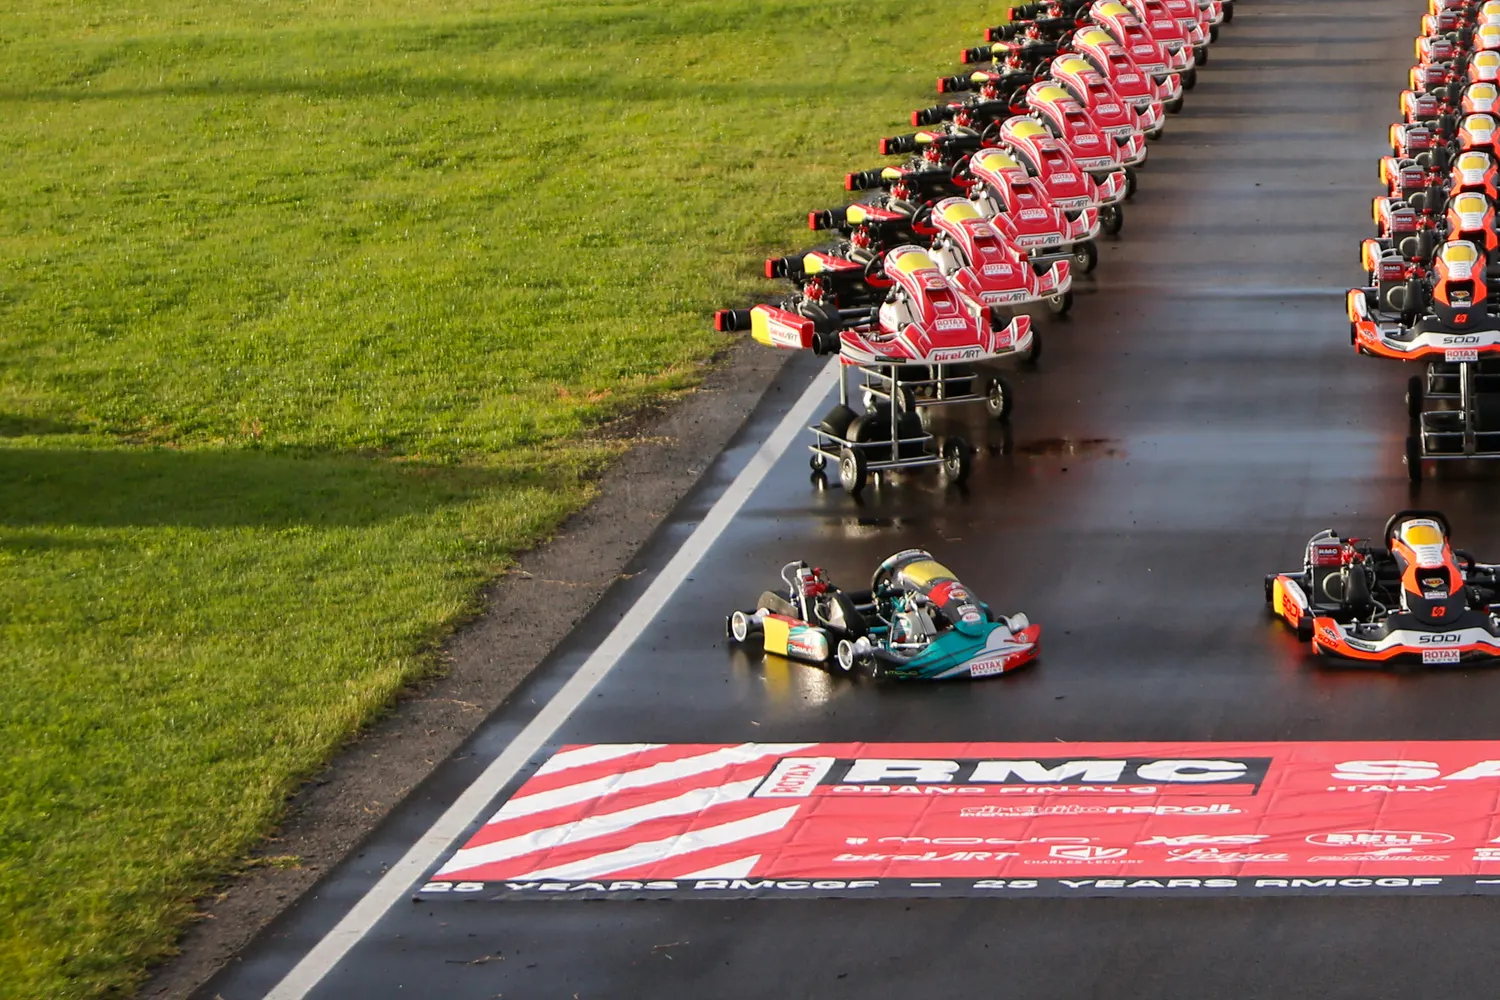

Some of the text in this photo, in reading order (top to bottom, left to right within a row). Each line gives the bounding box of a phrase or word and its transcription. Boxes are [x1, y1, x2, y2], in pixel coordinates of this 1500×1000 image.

[936, 318, 964, 327] ROTAX
[1443, 335, 1480, 345] SODI
[934, 348, 981, 361] birelART
[1419, 634, 1461, 644] SODI
[1424, 650, 1459, 658] ROTAX
[971, 659, 1003, 672] ROTAX
[843, 759, 1248, 783] RMC
[1326, 833, 1432, 844] BELL
[419, 881, 485, 893] 25
[505, 881, 679, 892] YEARS
[694, 879, 880, 890] RMCGF
[972, 879, 1038, 889] 25
[1058, 879, 1238, 889] YEARS
[1255, 878, 1443, 888] RMCGF
